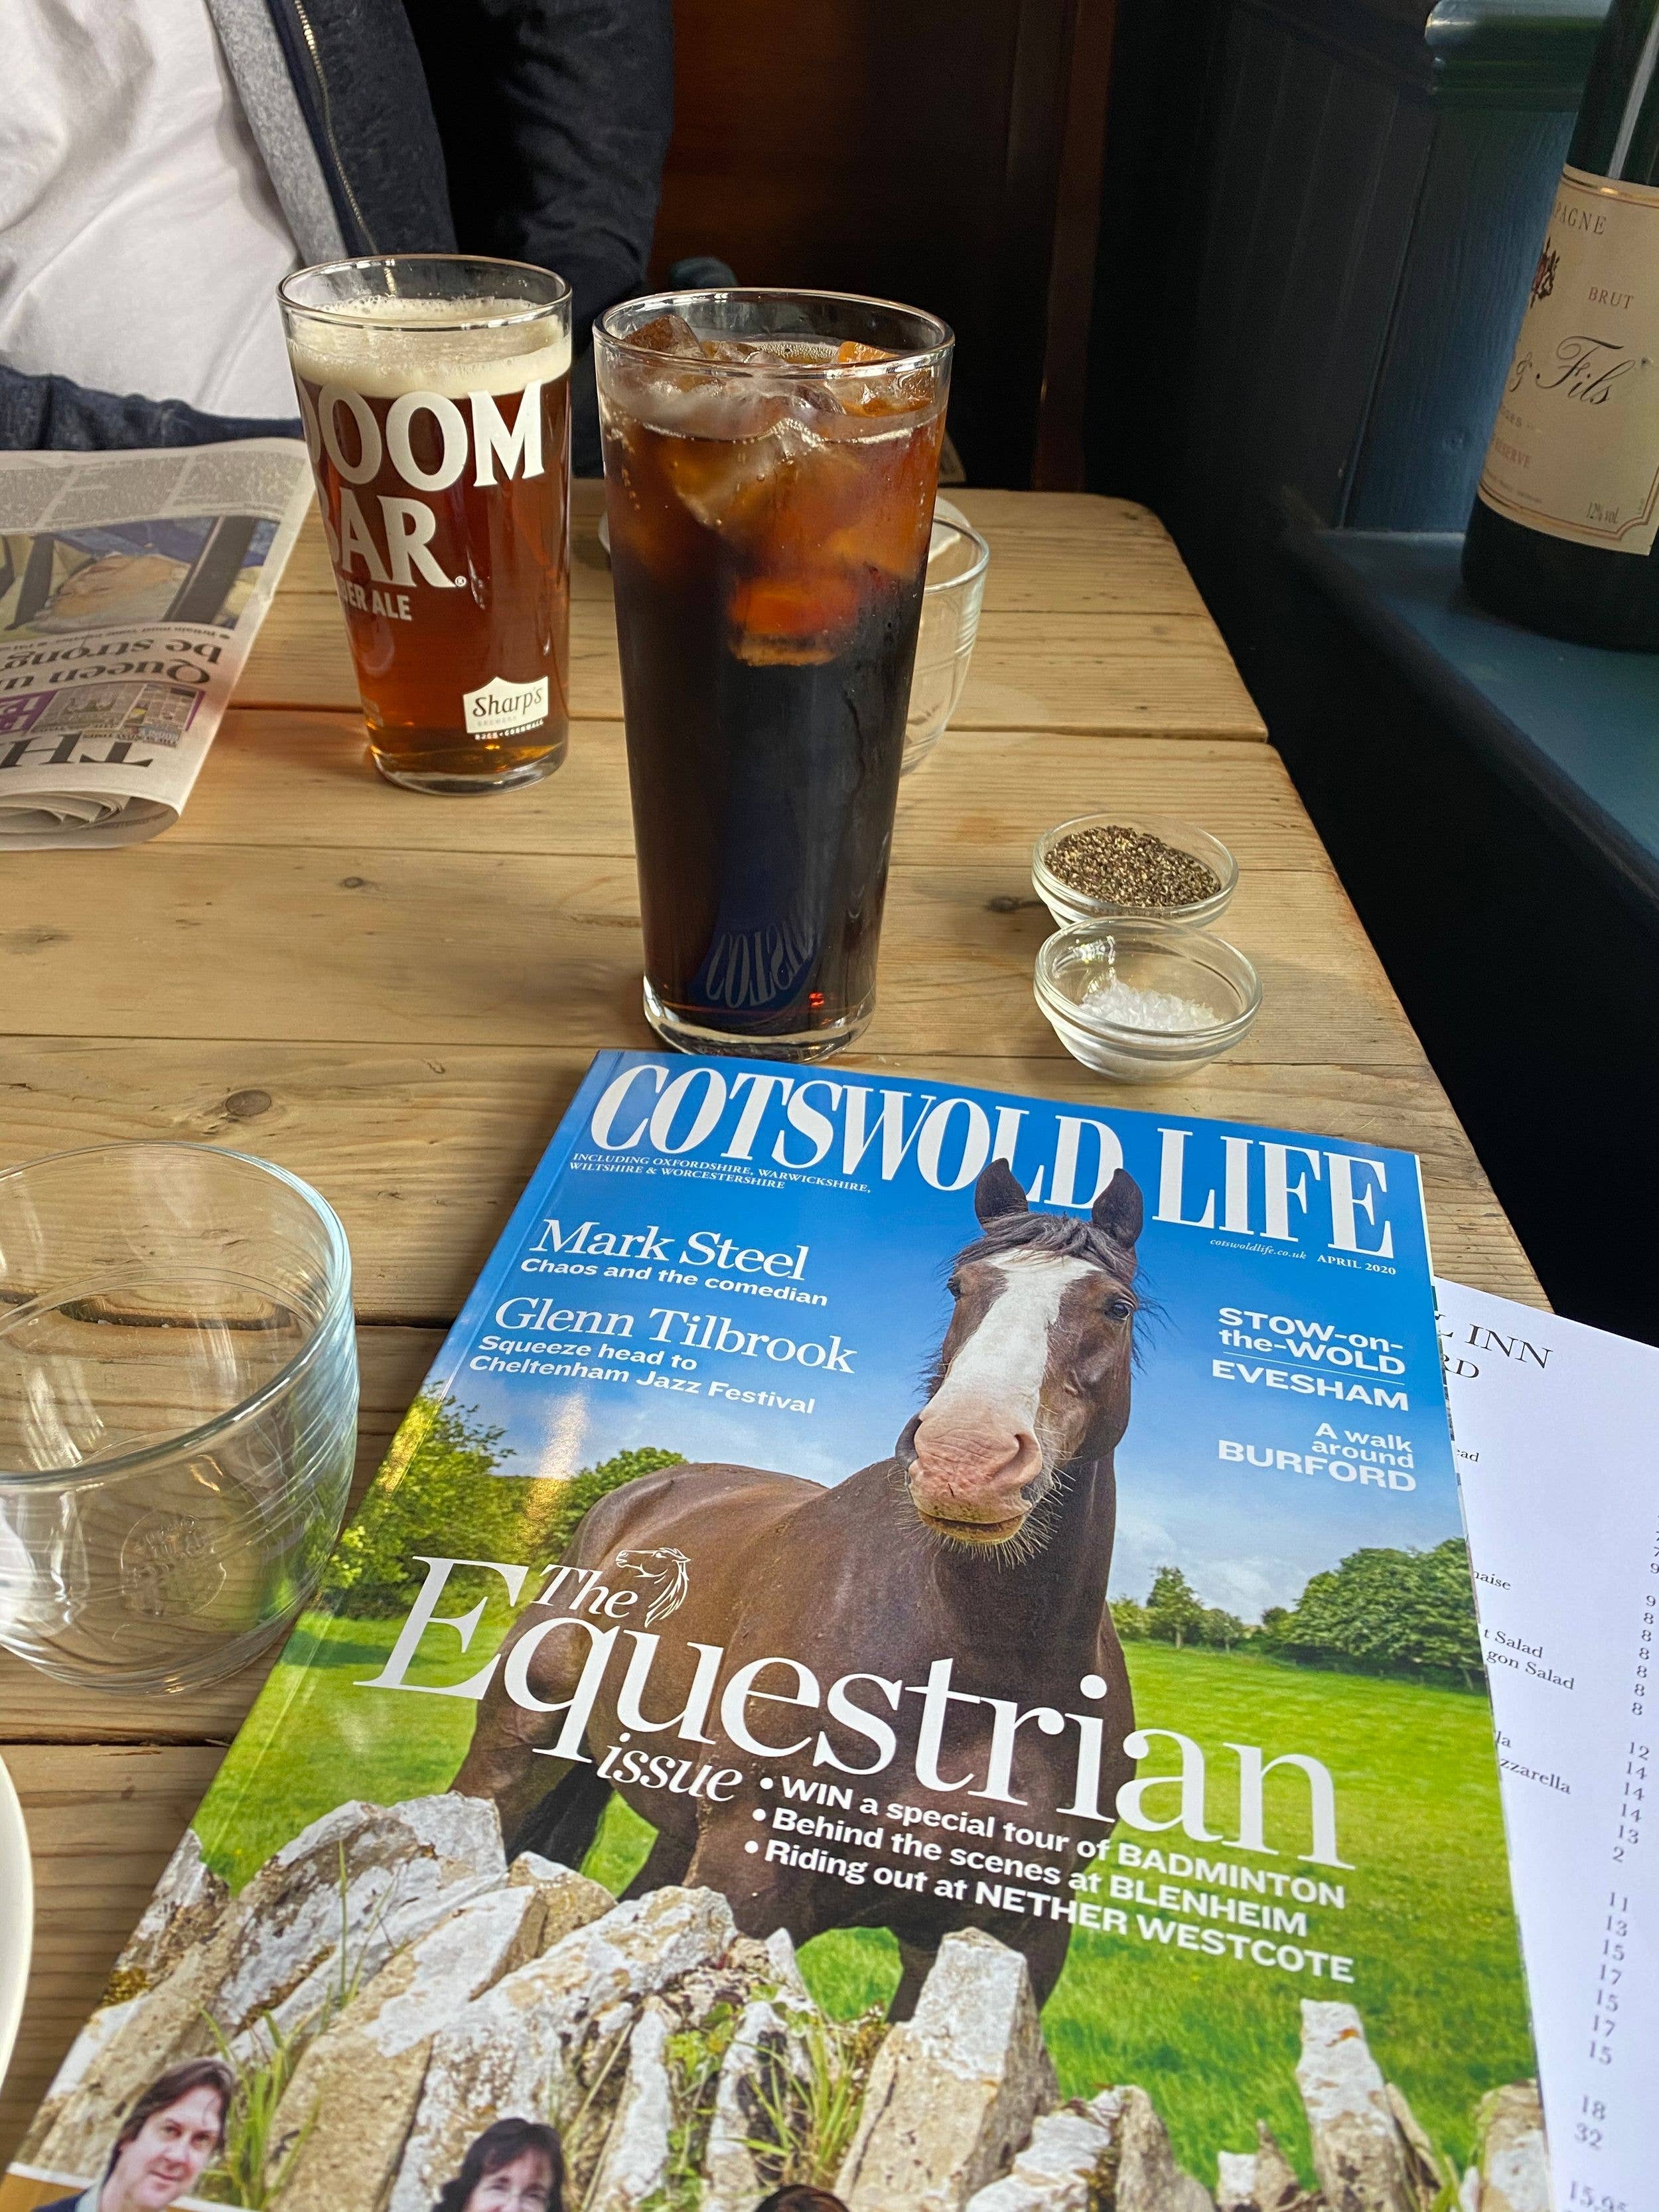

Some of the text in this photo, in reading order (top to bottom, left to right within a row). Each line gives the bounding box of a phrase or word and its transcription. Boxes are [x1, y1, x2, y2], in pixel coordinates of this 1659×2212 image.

[1587, 286, 1634, 309] BRUT
[1536, 335, 1636, 405] Fils
[372, 589, 413, 621] ALE
[2, 638, 223, 670] be strong
[48, 658, 210, 684] Queen
[472, 686, 542, 717] Sharp's
[569, 1161, 643, 1173] WILTSHIRE
[662, 1167, 786, 1189] WORCESTERSHIRE
[573, 1153, 871, 1193] INCLUDING OXFORDSHIRE, WARWICKSHIRE,
[591, 1064, 1394, 1259] COTSWOLD LIFE
[530, 1218, 810, 1281] Mark Steel
[1210, 1238, 1397, 1276] cotswoldlife.co.uk APRIL 2020
[520, 1258, 829, 1307] Chaos and the comedian
[494, 1295, 859, 1374] Glenn Tilbrook
[1218, 1307, 1404, 1353] STOW-on-
[478, 1335, 698, 1371] Squeeze head to
[1218, 1329, 1406, 1376] the-WOLD
[1465, 1323, 1554, 1370] INN
[469, 1355, 816, 1416] Cheltenham Jazz Festival
[1212, 1359, 1409, 1412] EVESHAM
[1314, 1422, 1413, 1453] A walk
[1218, 1439, 1417, 1492] BURFORD
[1311, 1439, 1414, 1469] around
[531, 1562, 640, 1619] The
[1646, 1595, 1656, 1607] 9
[1643, 1612, 1654, 1625] 8
[1494, 1630, 1544, 1659] Salad
[1641, 1629, 1652, 1642] 8
[1638, 1647, 1650, 1660] 8
[1486, 1649, 1575, 1690] gon Salad
[1636, 1665, 1647, 1678] 8
[1634, 1683, 1645, 1697] 8
[352, 1555, 1356, 1872] Equestrian
[1632, 1702, 1643, 1716] 8
[1629, 1741, 1650, 1761] 12
[597, 1732, 743, 1803] issue
[1500, 1758, 1571, 1795] zzarella
[1627, 1761, 1646, 1780] 14
[1624, 1782, 1642, 1801] 14
[1621, 1803, 1640, 1822] 14
[781, 1775, 1346, 1910] WIN a special tour of BADMINTON
[1619, 1824, 1639, 1844] 13
[1613, 1846, 1624, 1863] 2
[772, 1806, 1307, 1938] Behind the scenes at BLENHEIM
[764, 1838, 1356, 1984] Riding out at NETHER WESTCOTE
[1609, 1891, 1628, 1912] 11
[1607, 1915, 1627, 1937] 13
[1603, 1939, 1625, 1961] 15
[1600, 1964, 1622, 1985] 17
[1597, 1989, 1619, 2012] 15
[1593, 2014, 1616, 2037] 17
[1589, 2041, 1613, 2065] 15
[1582, 2095, 1606, 2121] 18
[1577, 2122, 1603, 2150] 32
